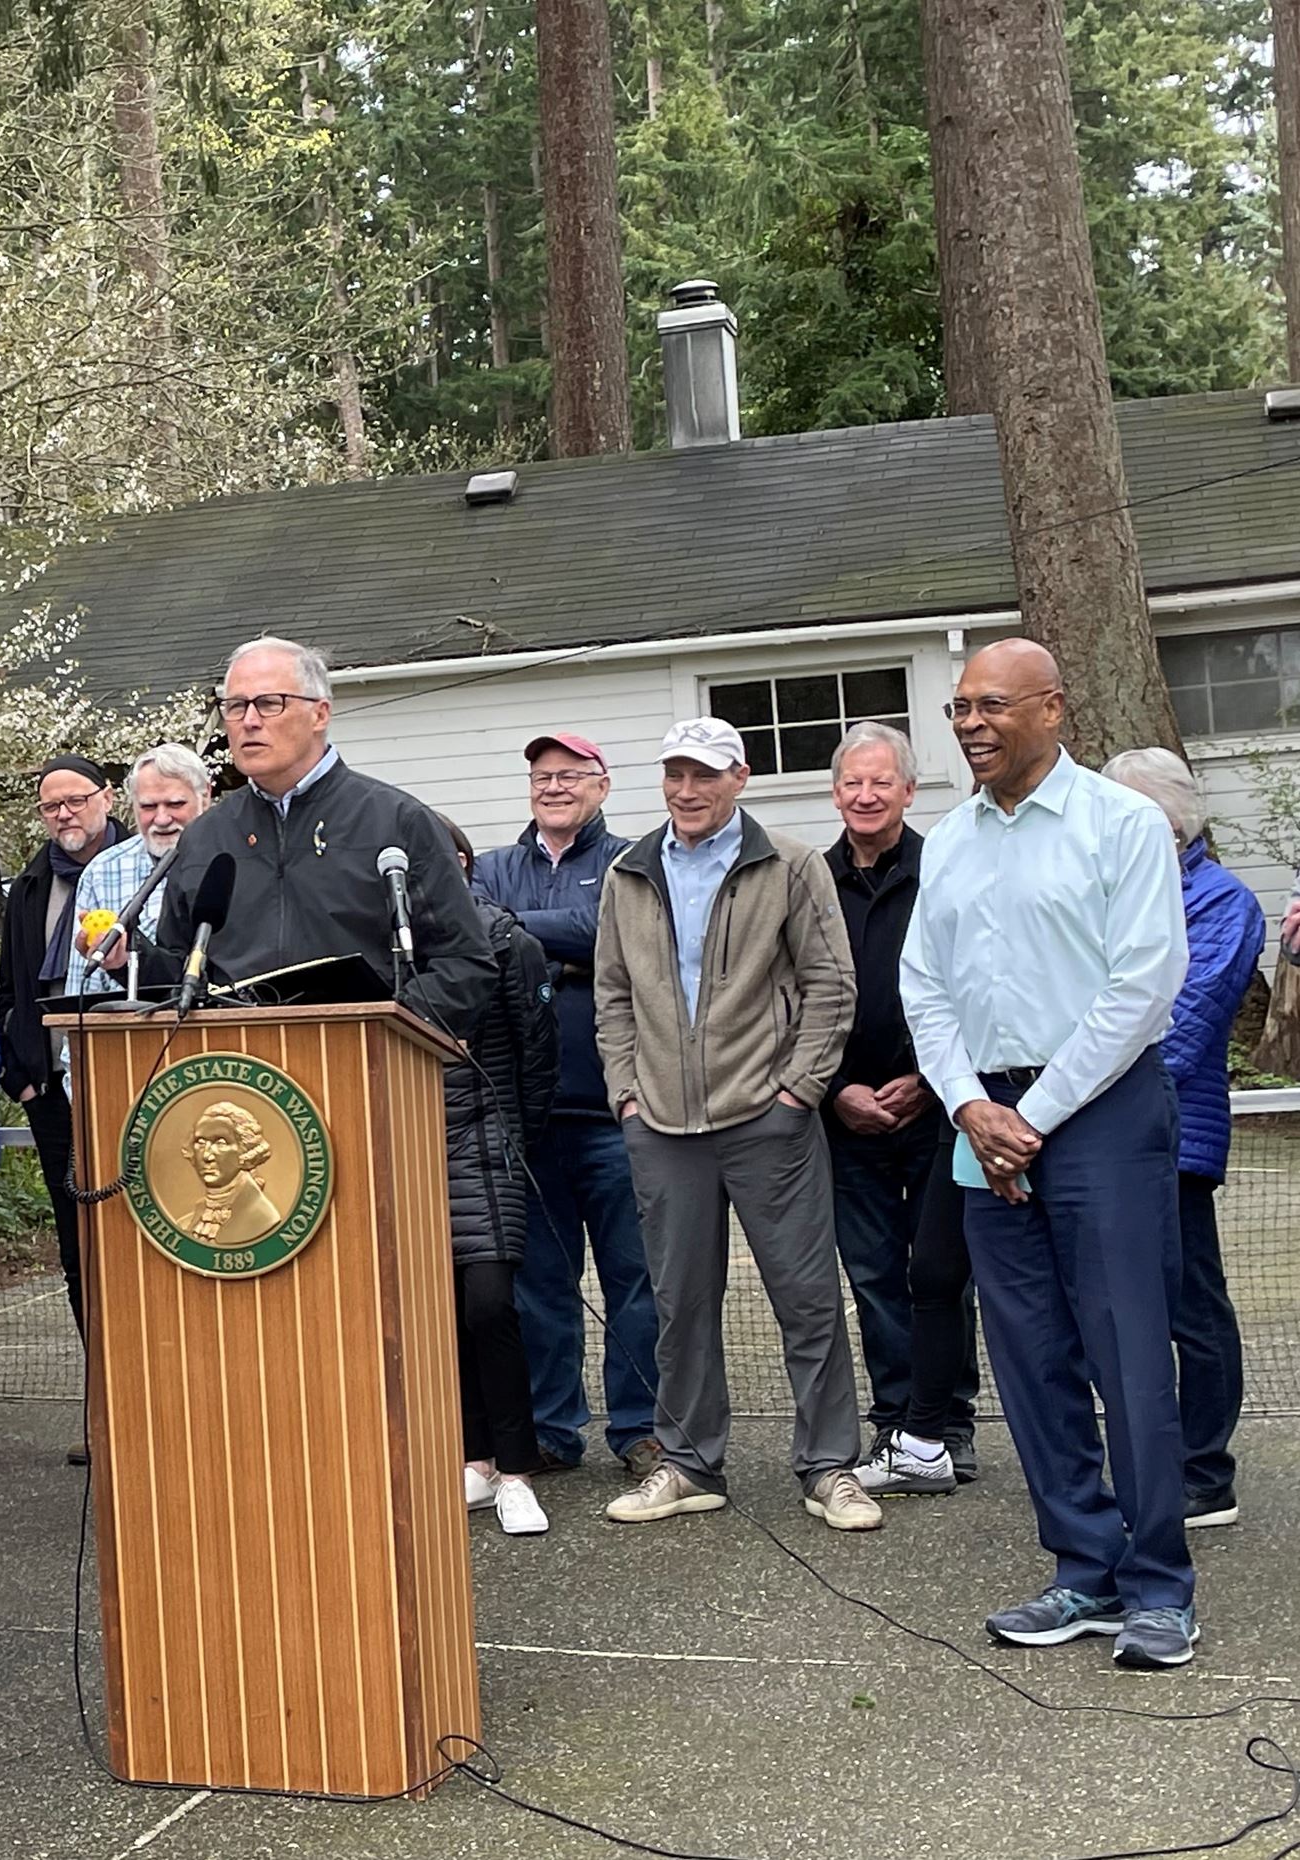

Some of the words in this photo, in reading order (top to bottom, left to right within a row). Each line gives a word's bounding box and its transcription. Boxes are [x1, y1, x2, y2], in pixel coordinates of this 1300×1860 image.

[183, 1061, 252, 1083] STATE
[257, 1072, 288, 1099] OF
[141, 1074, 183, 1112] THE
[128, 1113, 149, 1145] OF
[282, 1093, 326, 1248] WASHINGTON
[143, 1210, 183, 1253] THE
[211, 1252, 255, 1271] 1889
